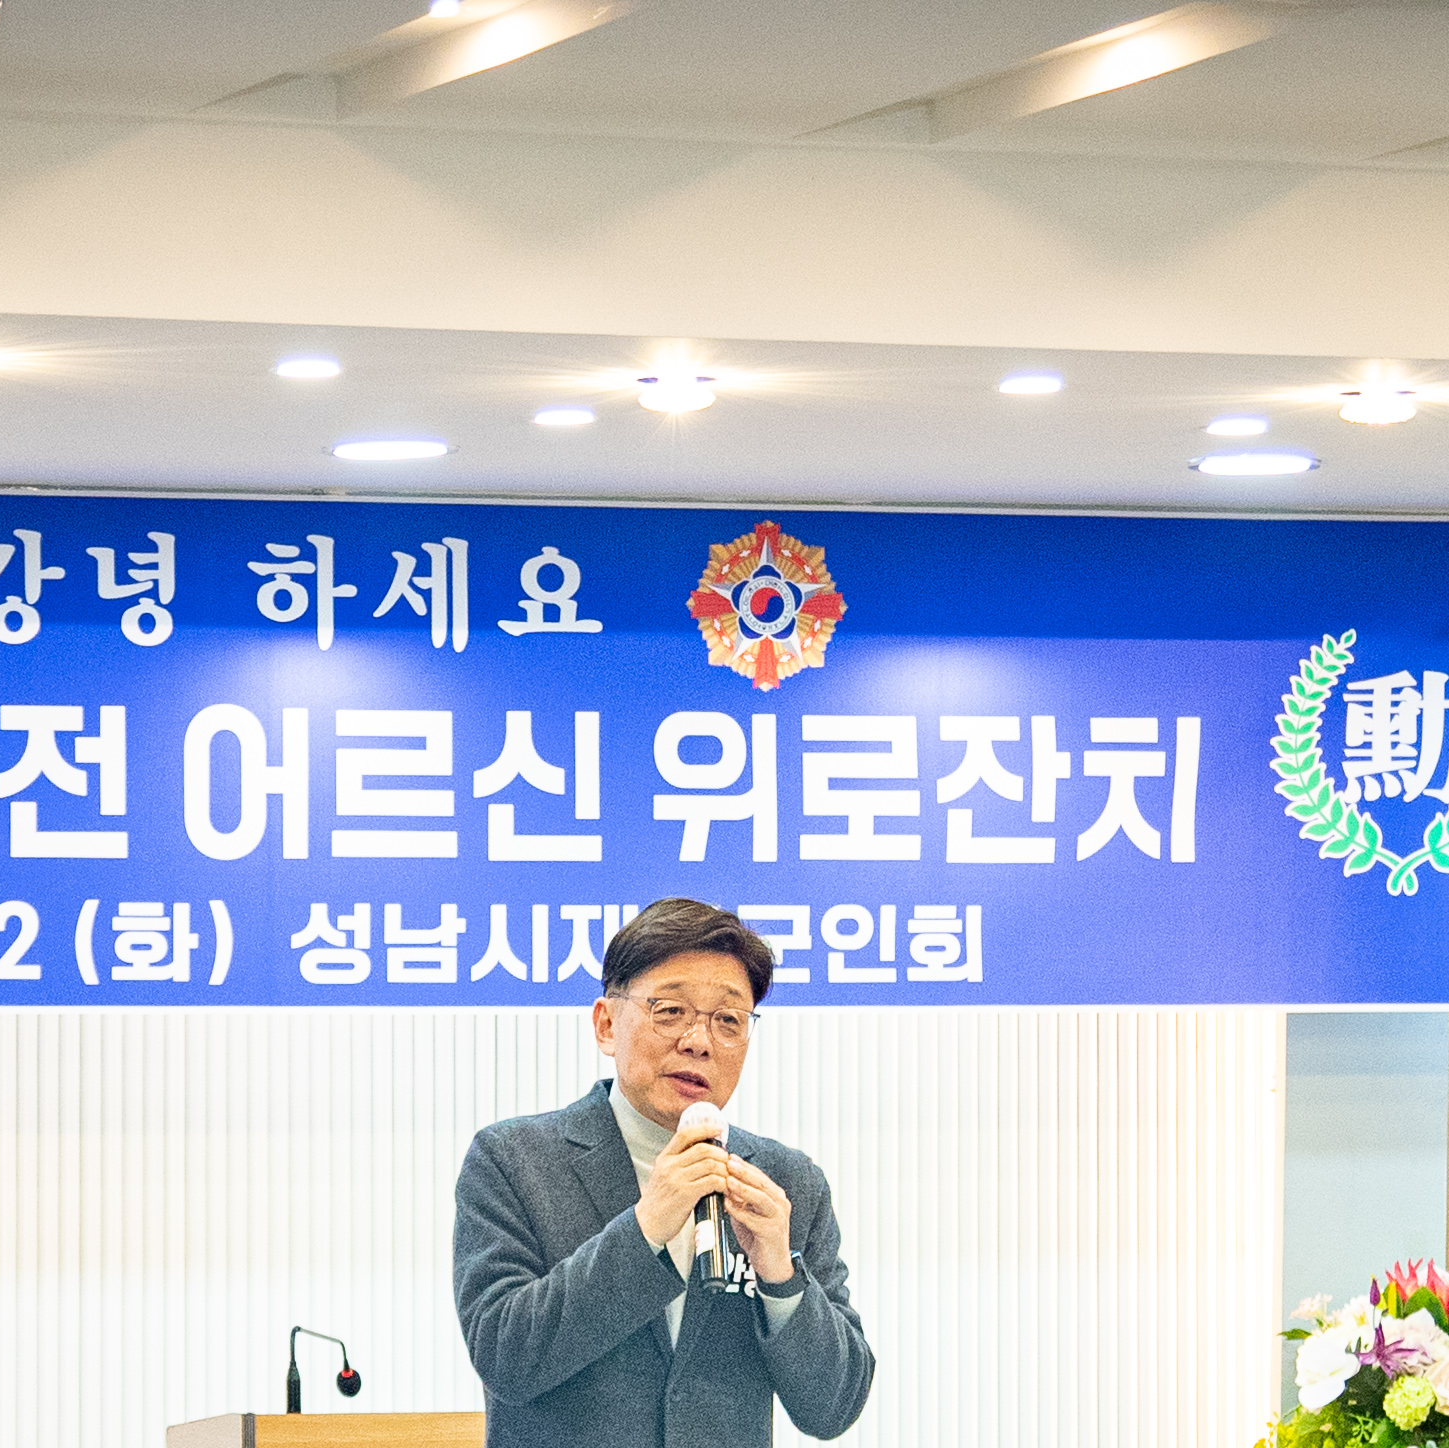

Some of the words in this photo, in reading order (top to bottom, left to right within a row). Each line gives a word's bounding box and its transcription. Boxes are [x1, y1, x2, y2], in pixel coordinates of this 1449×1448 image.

[246, 533, 604, 654] 하세요
[183, 702, 604, 863] 어르신
[651, 710, 1202, 865] 위로잔치
[289, 899, 984, 986] 성남시재군인회
